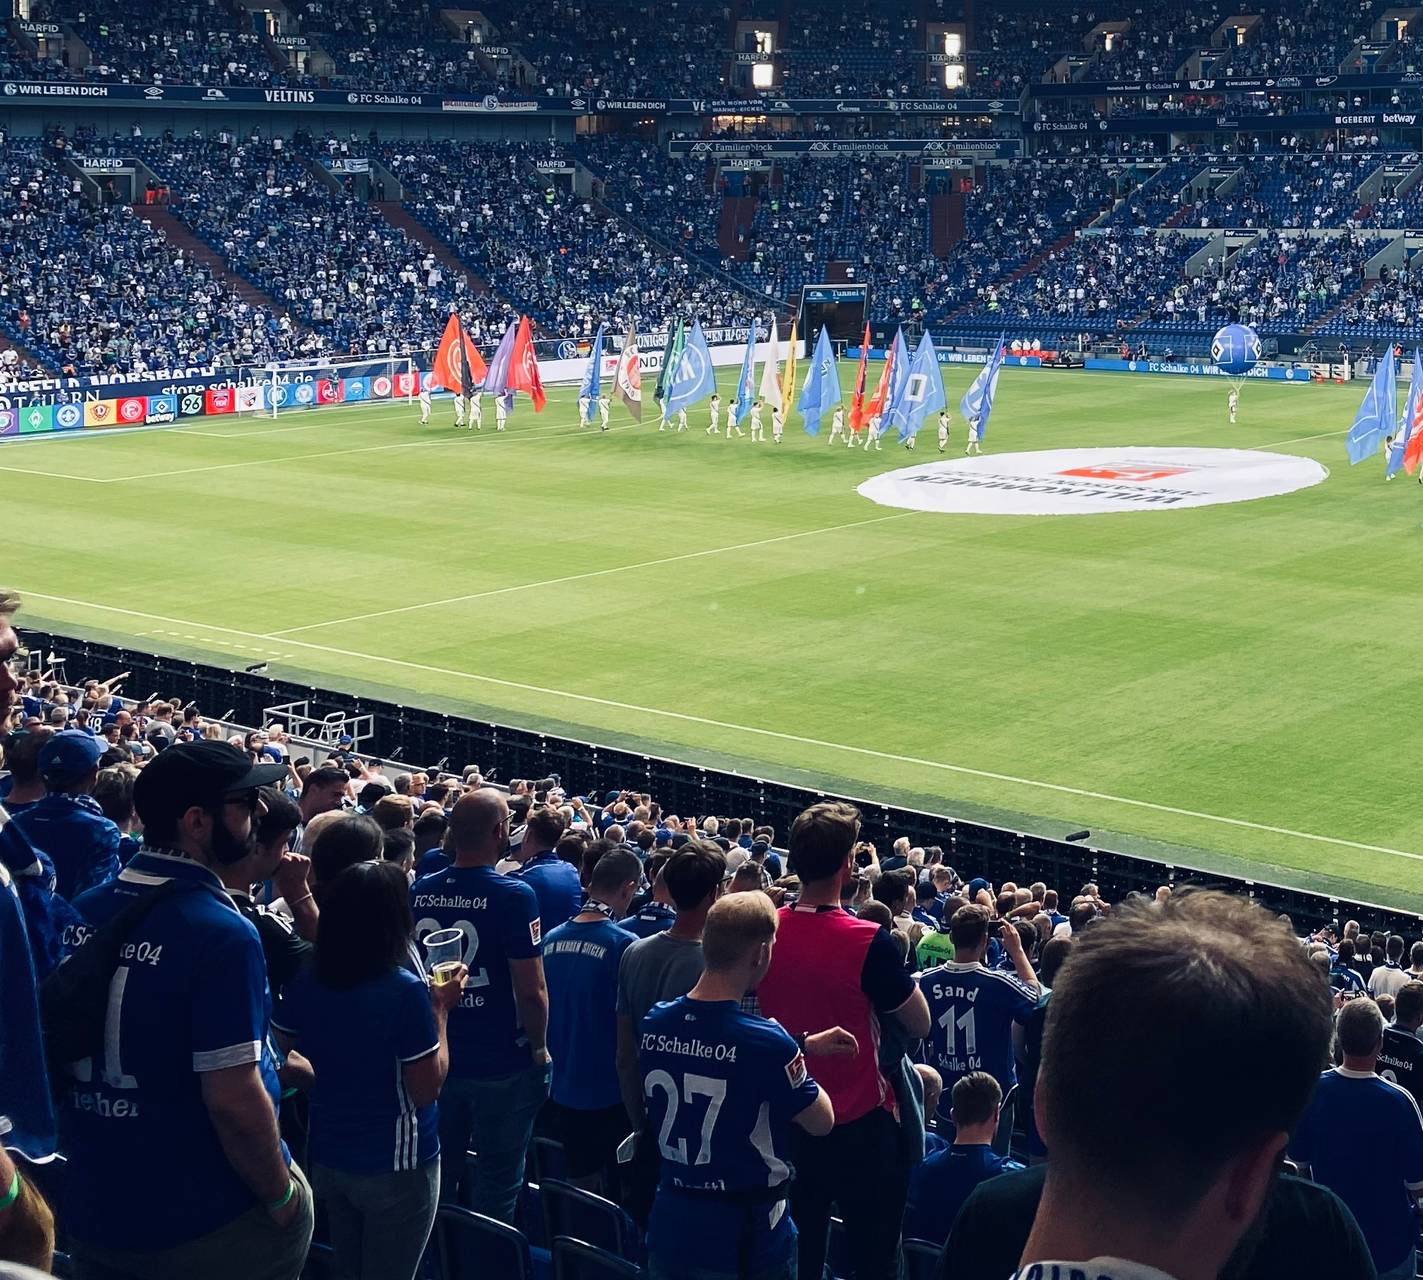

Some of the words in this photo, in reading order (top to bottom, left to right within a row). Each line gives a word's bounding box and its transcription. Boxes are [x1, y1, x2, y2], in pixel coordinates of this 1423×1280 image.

[20, 23, 59, 33] HARFID
[273, 36, 307, 45] HARFID
[19, 84, 40, 94] WIR
[43, 85, 79, 95] LEBEN
[81, 86, 108, 96] DICH
[264, 90, 314, 103] VELTINS
[360, 94, 372, 104] FC
[374, 95, 409, 105] Schalke
[411, 96, 421, 105] 04
[648, 102, 666, 110] DICH
[900, 101, 912, 110] FC
[913, 101, 945, 110] Schalke
[947, 102, 957, 110] 04
[1341, 114, 1376, 124] GEBERIT
[1382, 112, 1417, 125] betway
[1042, 122, 1051, 130] FC
[1052, 122, 1078, 131] Schalke
[1079, 122, 1088, 131] 04
[83, 158, 123, 168] HARFID
[536, 160, 566, 169] HARFID
[832, 289, 859, 297] Tunnel
[948, 353, 962, 362] WIR
[963, 354, 986, 363] LEBEN
[1149, 362, 1159, 371] FC
[1160, 363, 1188, 374] Schalke
[1190, 365, 1199, 374] 04
[1202, 365, 1218, 375] WIR
[903, 474, 1185, 504] WILLKOMMEN
[413, 893, 428, 908] FC
[428, 894, 473, 909] Schalke
[473, 895, 488, 910] 04
[932, 983, 980, 1003] Sand
[937, 1004, 977, 1056] 11
[640, 1032, 656, 1051] FC
[656, 1034, 713, 1058] Schalke
[714, 1044, 737, 1063] 04
[967, 1055, 982, 1070] 04
[643, 1068, 728, 1167] 27
